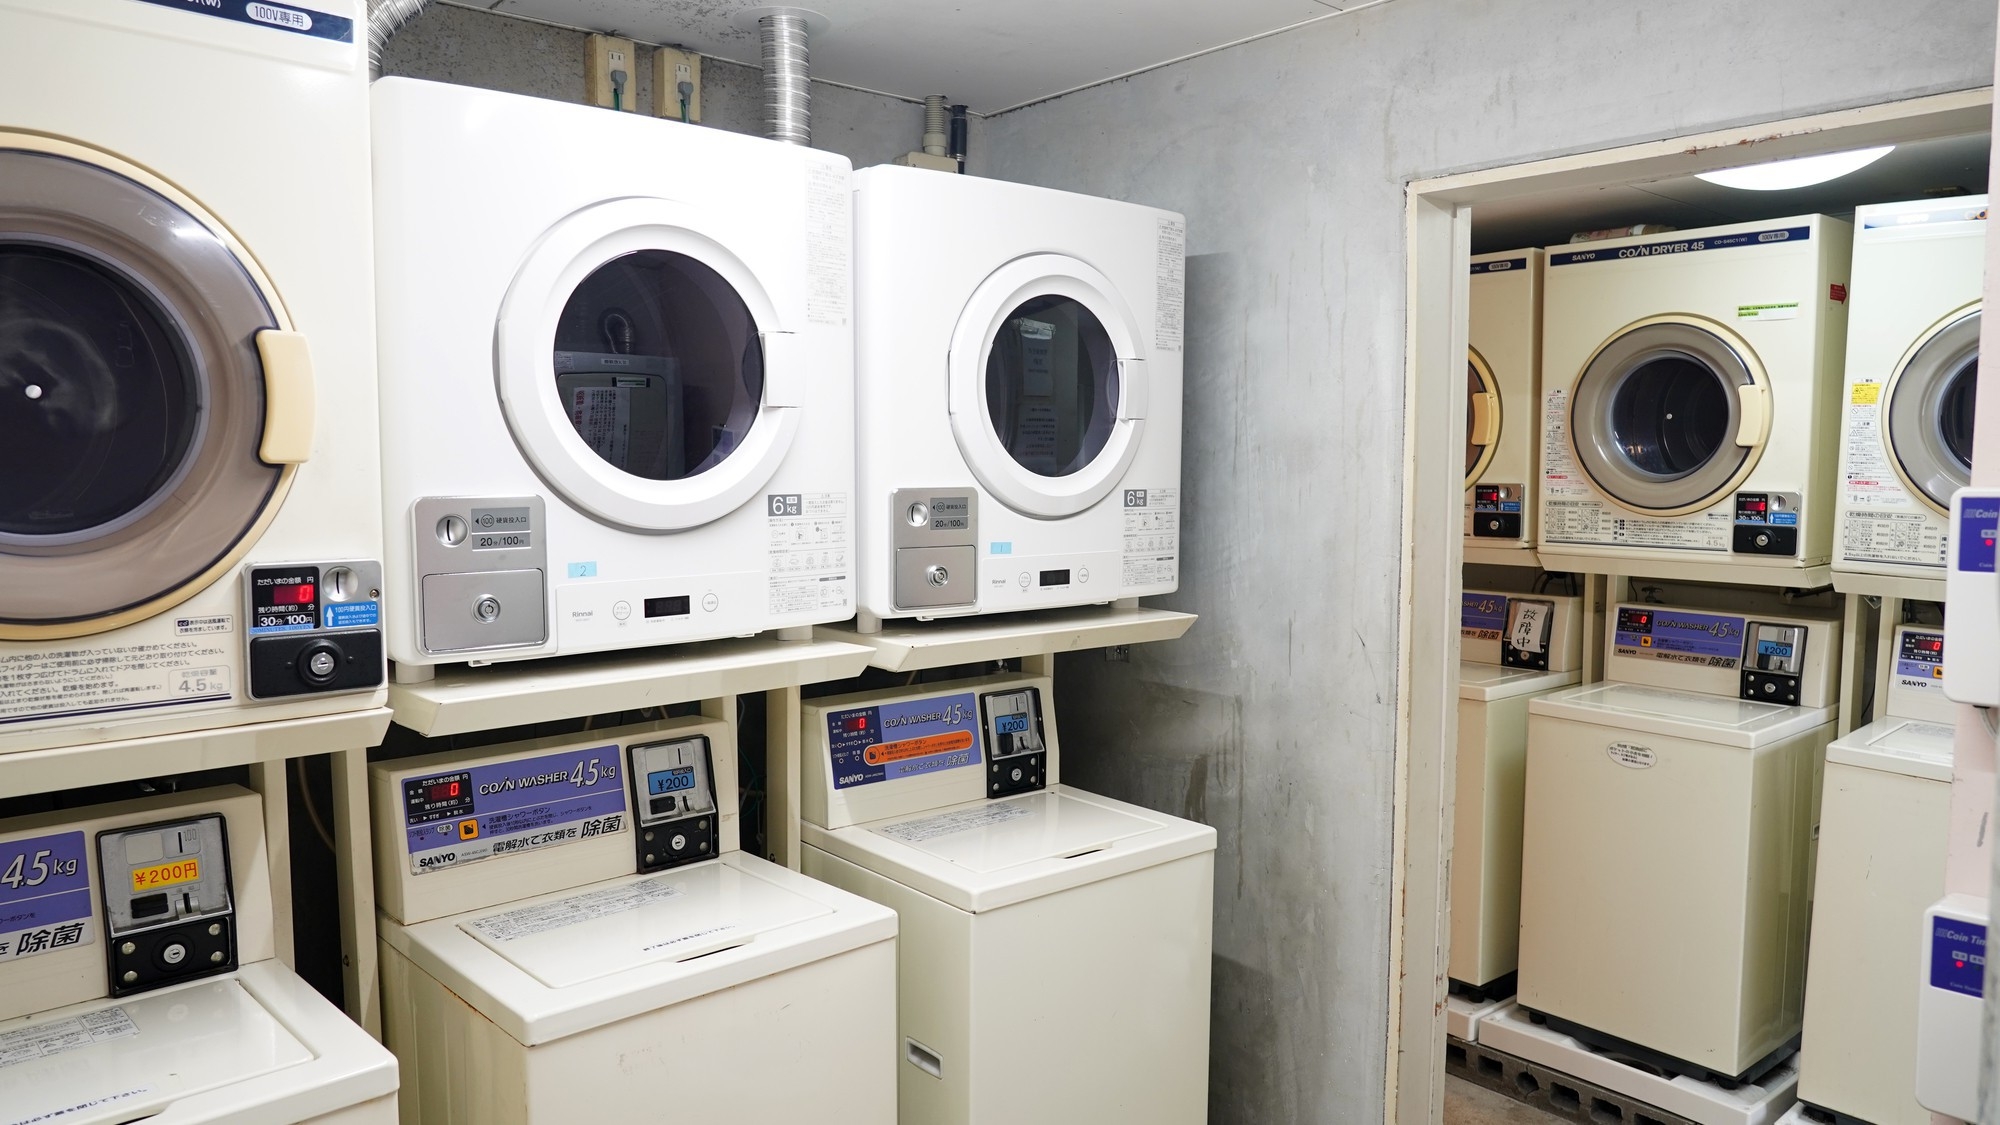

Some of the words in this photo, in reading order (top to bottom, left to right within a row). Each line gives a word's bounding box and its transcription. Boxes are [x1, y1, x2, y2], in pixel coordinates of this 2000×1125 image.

[1571, 252, 1596, 261] SANYO
[1652, 242, 1689, 255] DRYER
[1690, 241, 1705, 251] 45
[772, 496, 784, 515] 6
[786, 505, 797, 514] kg
[1127, 491, 1135, 506] 6
[579, 565, 587, 577] 2
[299, 584, 311, 602] 0
[572, 610, 594, 619] Rinnai
[1641, 615, 1648, 624] 0
[1516, 608, 1539, 648] 故障中
[1678, 621, 1709, 631] WASHER
[1764, 645, 1788, 656] ¥200
[1932, 642, 1942, 651] 0
[1707, 656, 1737, 668] 除菌
[178, 678, 208, 693] 4.5
[209, 681, 224, 691] kg
[1901, 679, 1927, 688] SANYO
[858, 718, 866, 729] 0
[908, 712, 942, 725] WASHER
[962, 709, 974, 721] kg
[1001, 719, 1025, 732] ¥200
[518, 771, 569, 789] WASHER
[569, 758, 600, 788] 4.5
[600, 765, 617, 779] kg
[838, 773, 864, 785] SANYO
[449, 782, 460, 797] 0
[657, 775, 690, 792] ¥200
[492, 827, 578, 853] 電解水で衣類を
[580, 815, 623, 839] 除菌
[419, 852, 456, 868] SANYO
[1, 850, 52, 890] 4.5
[53, 858, 79, 876] kg
[135, 862, 199, 886] ¥200円
[15, 922, 86, 956] 除菌
[1946, 930, 1969, 943] Coin
